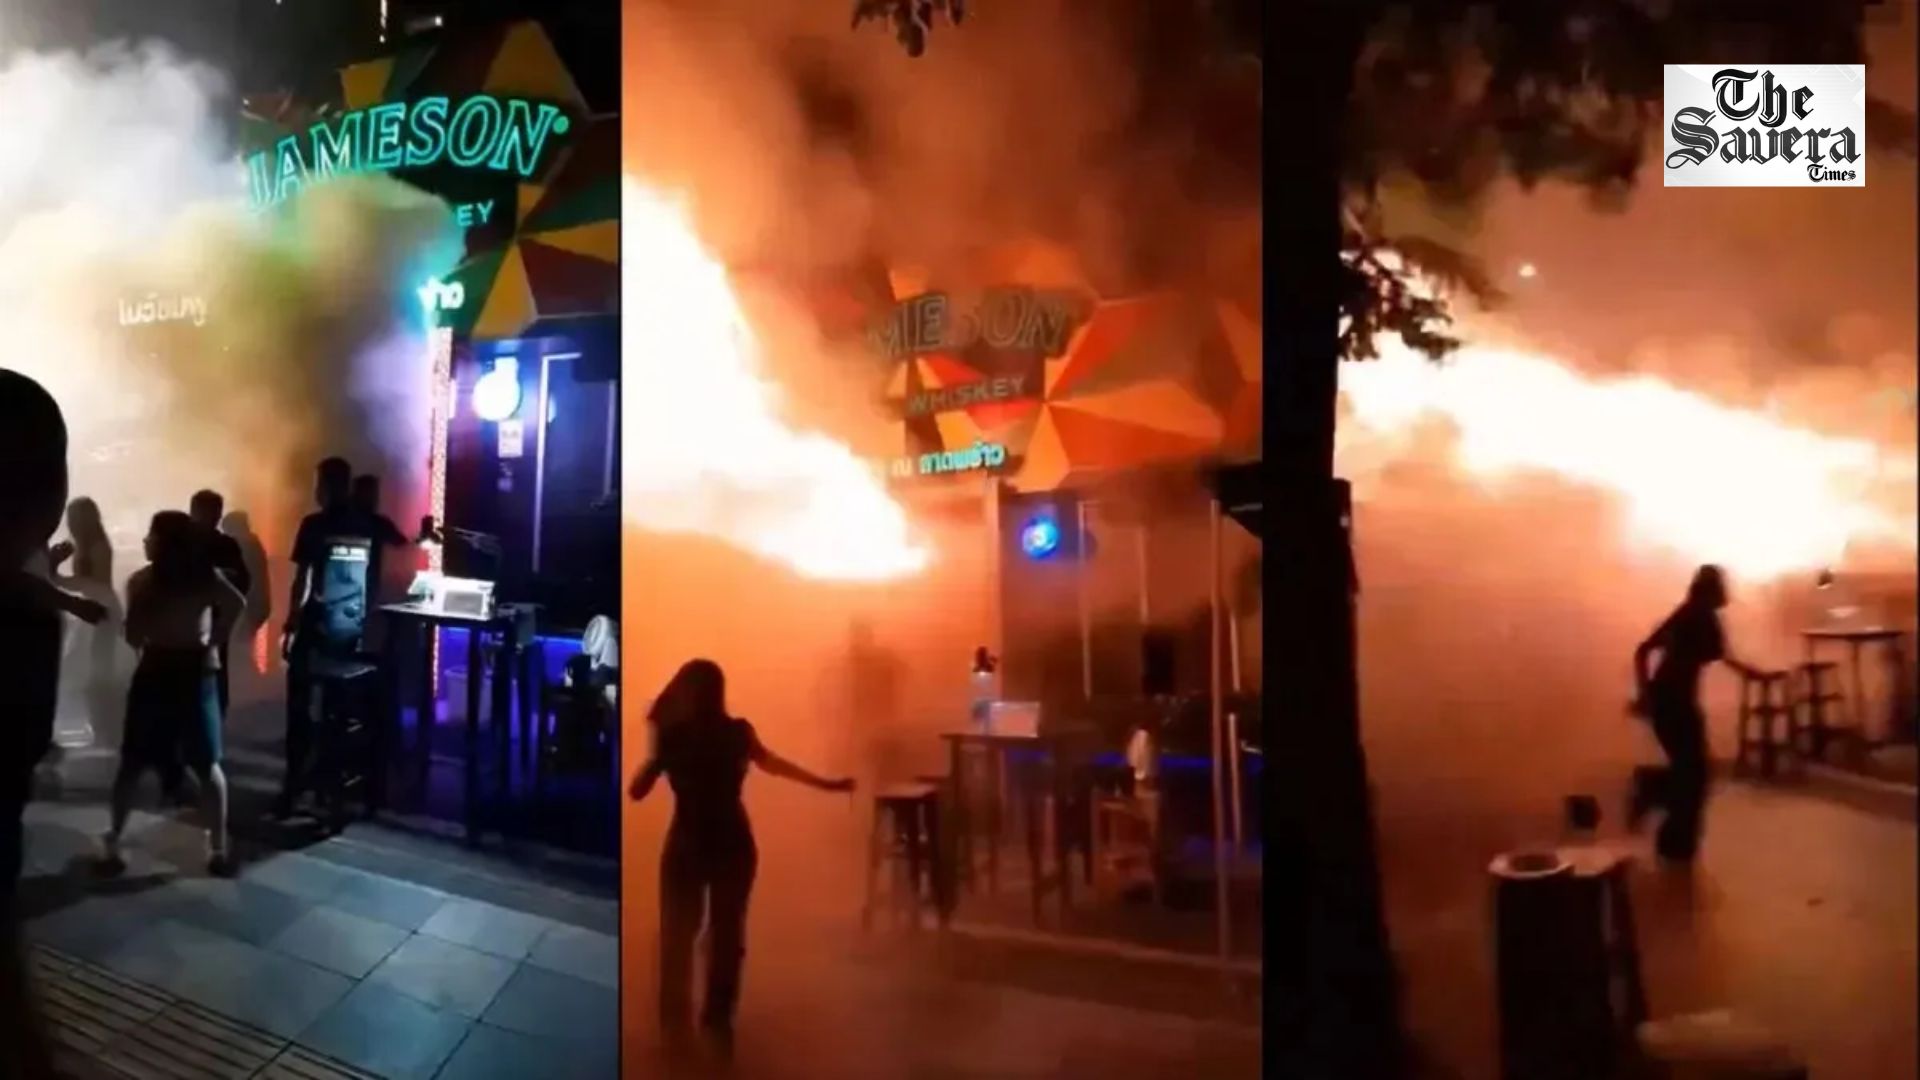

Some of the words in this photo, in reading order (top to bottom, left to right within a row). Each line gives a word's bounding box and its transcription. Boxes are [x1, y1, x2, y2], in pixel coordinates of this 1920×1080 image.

[248, 95, 561, 213] JAMESON
[864, 291, 1069, 357] MESON
[908, 375, 1026, 415] WHISKEY
